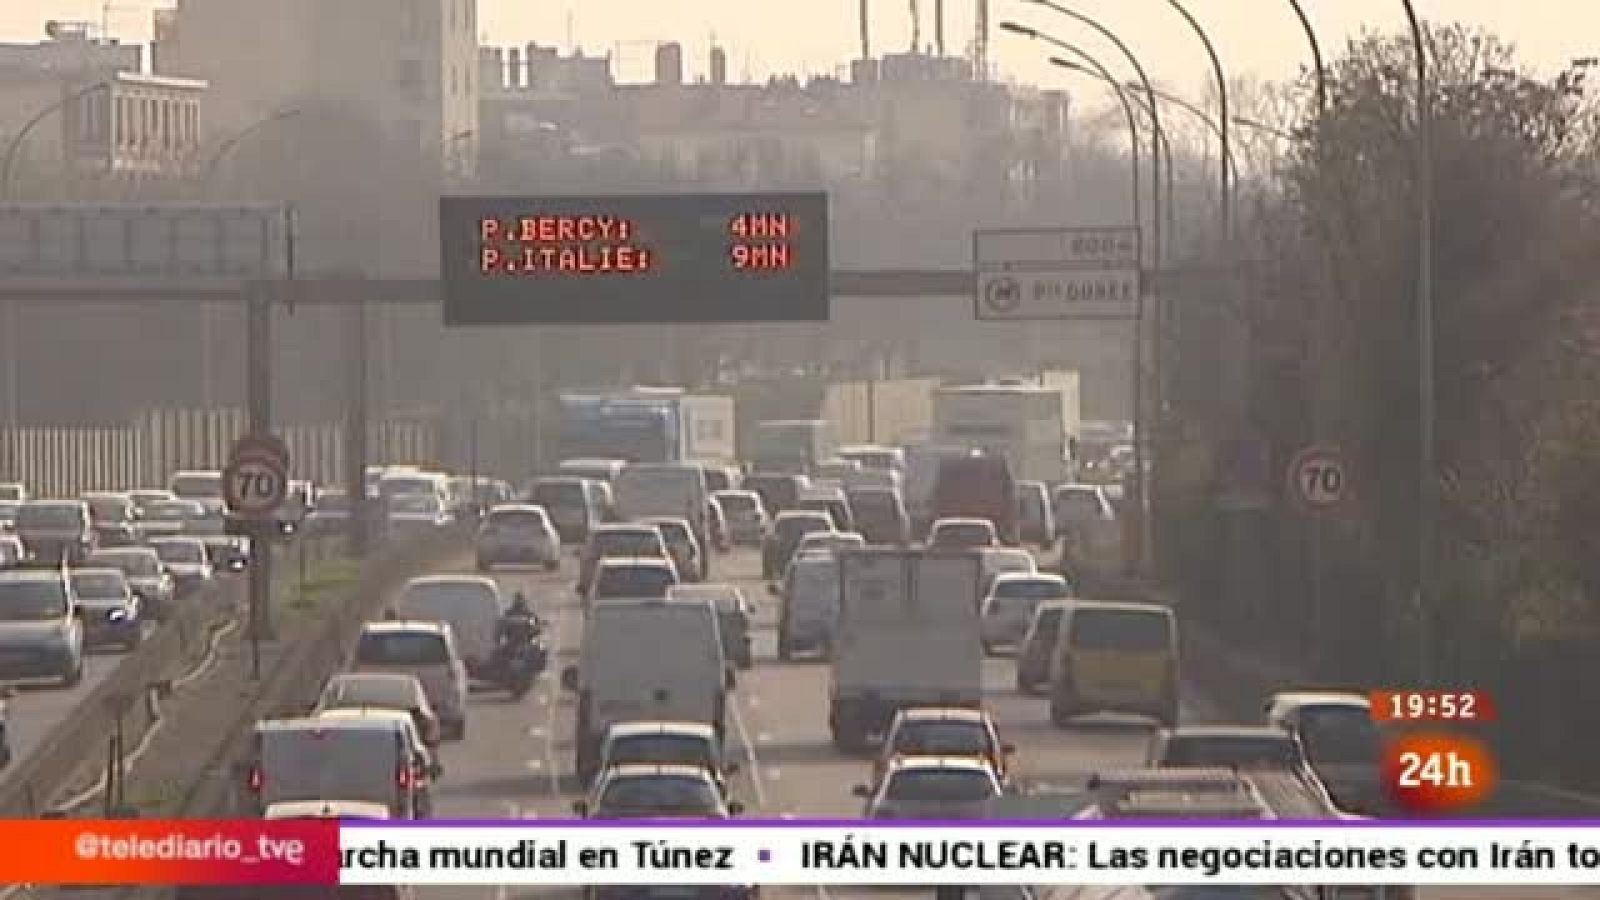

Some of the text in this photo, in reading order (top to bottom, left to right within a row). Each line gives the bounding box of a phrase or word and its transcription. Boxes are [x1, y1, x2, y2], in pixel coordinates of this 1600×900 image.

[481, 213, 787, 241] P.BERCY: 4MN
[481, 244, 787, 271] P.ITALIE: 9MN
[240, 471, 275, 500] 70
[1302, 465, 1342, 497] 70
